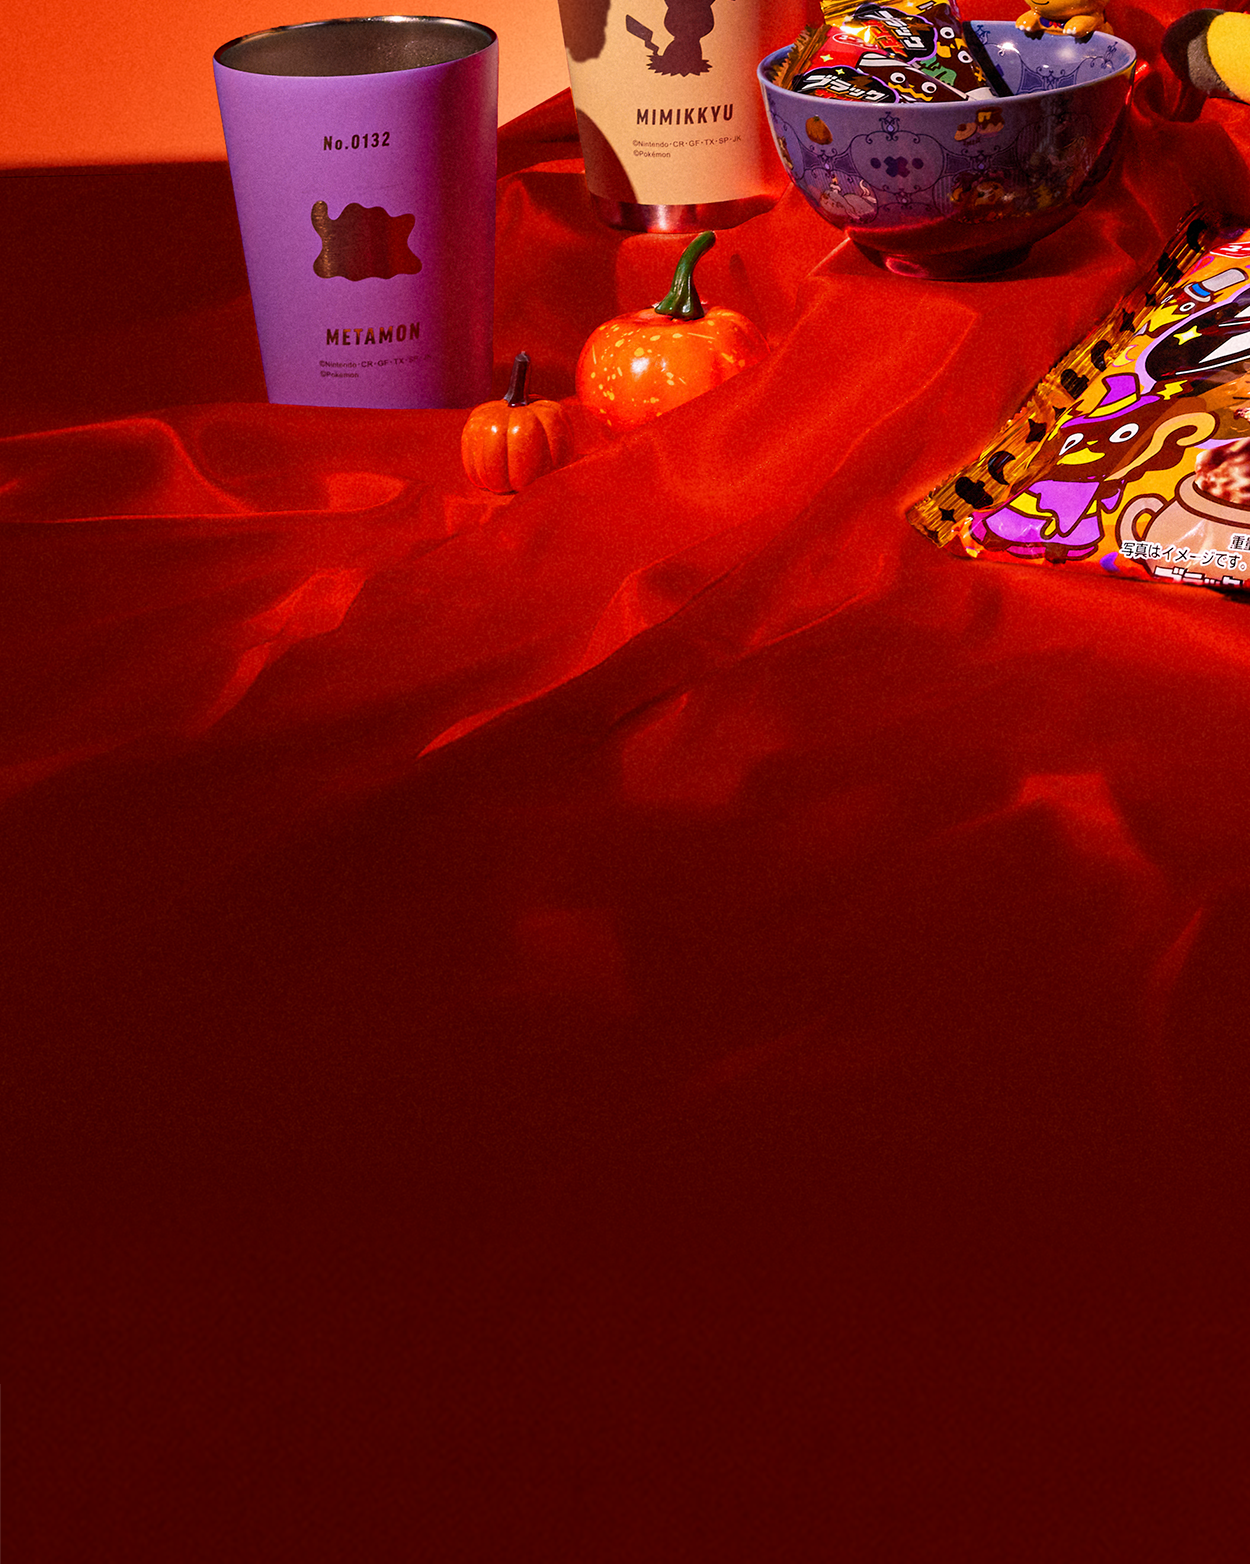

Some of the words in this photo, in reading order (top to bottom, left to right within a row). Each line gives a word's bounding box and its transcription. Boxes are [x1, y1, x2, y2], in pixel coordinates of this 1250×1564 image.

[800, 74, 887, 101] ブラック
[636, 103, 734, 126] MIMIKKYU
[323, 131, 391, 151] No.0132
[326, 322, 420, 346] METAMON
